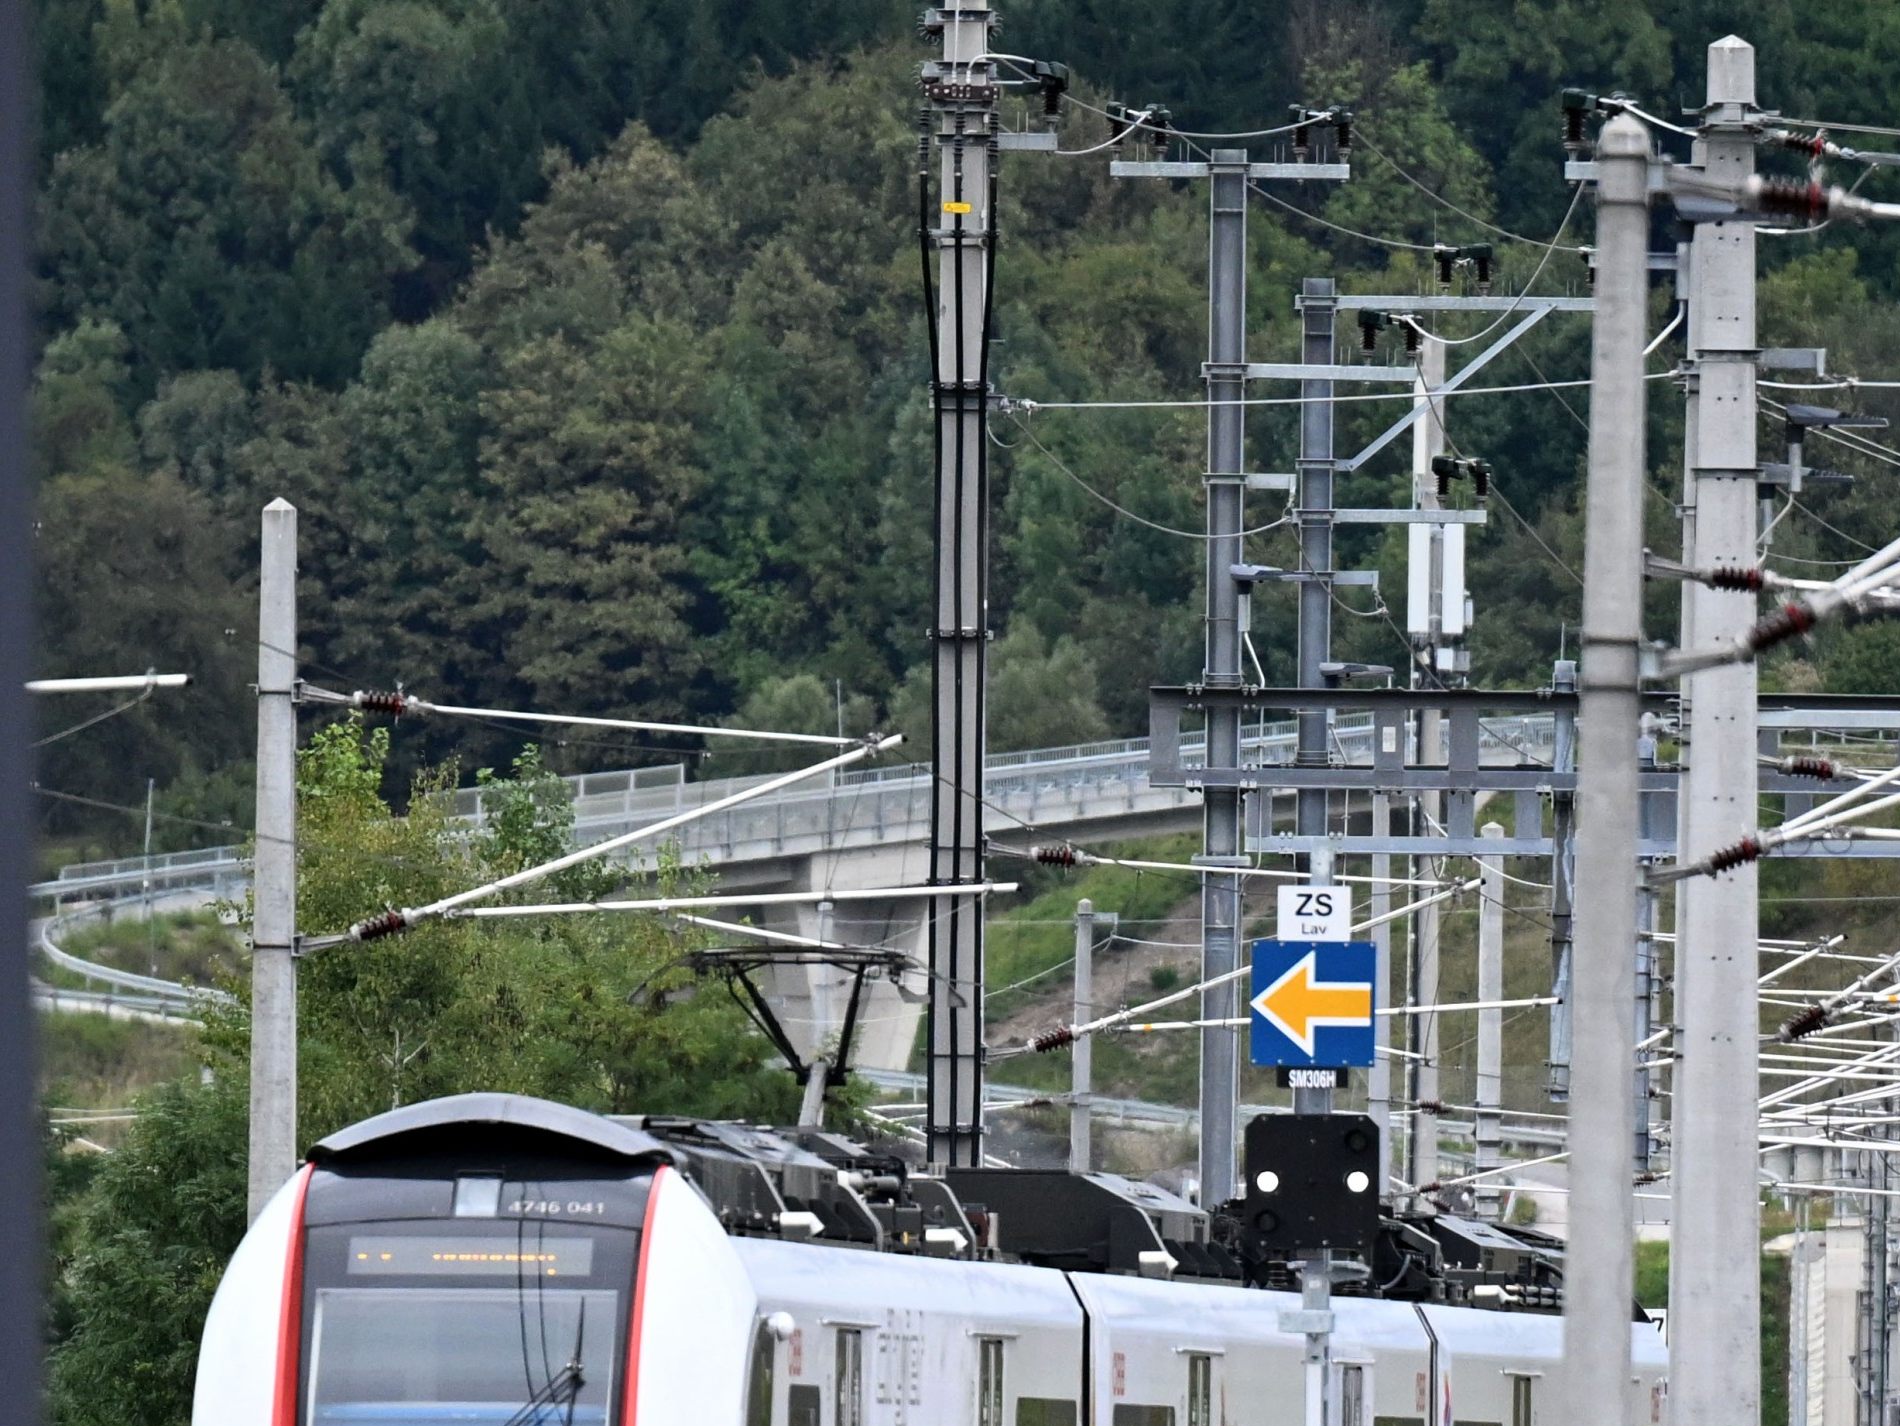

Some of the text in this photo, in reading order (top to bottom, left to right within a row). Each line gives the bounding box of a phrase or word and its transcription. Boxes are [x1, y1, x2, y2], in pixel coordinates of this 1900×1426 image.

[1295, 893, 1333, 916] ZS
[1301, 923, 1327, 935] Lav
[1288, 1069, 1337, 1088] SM306H
